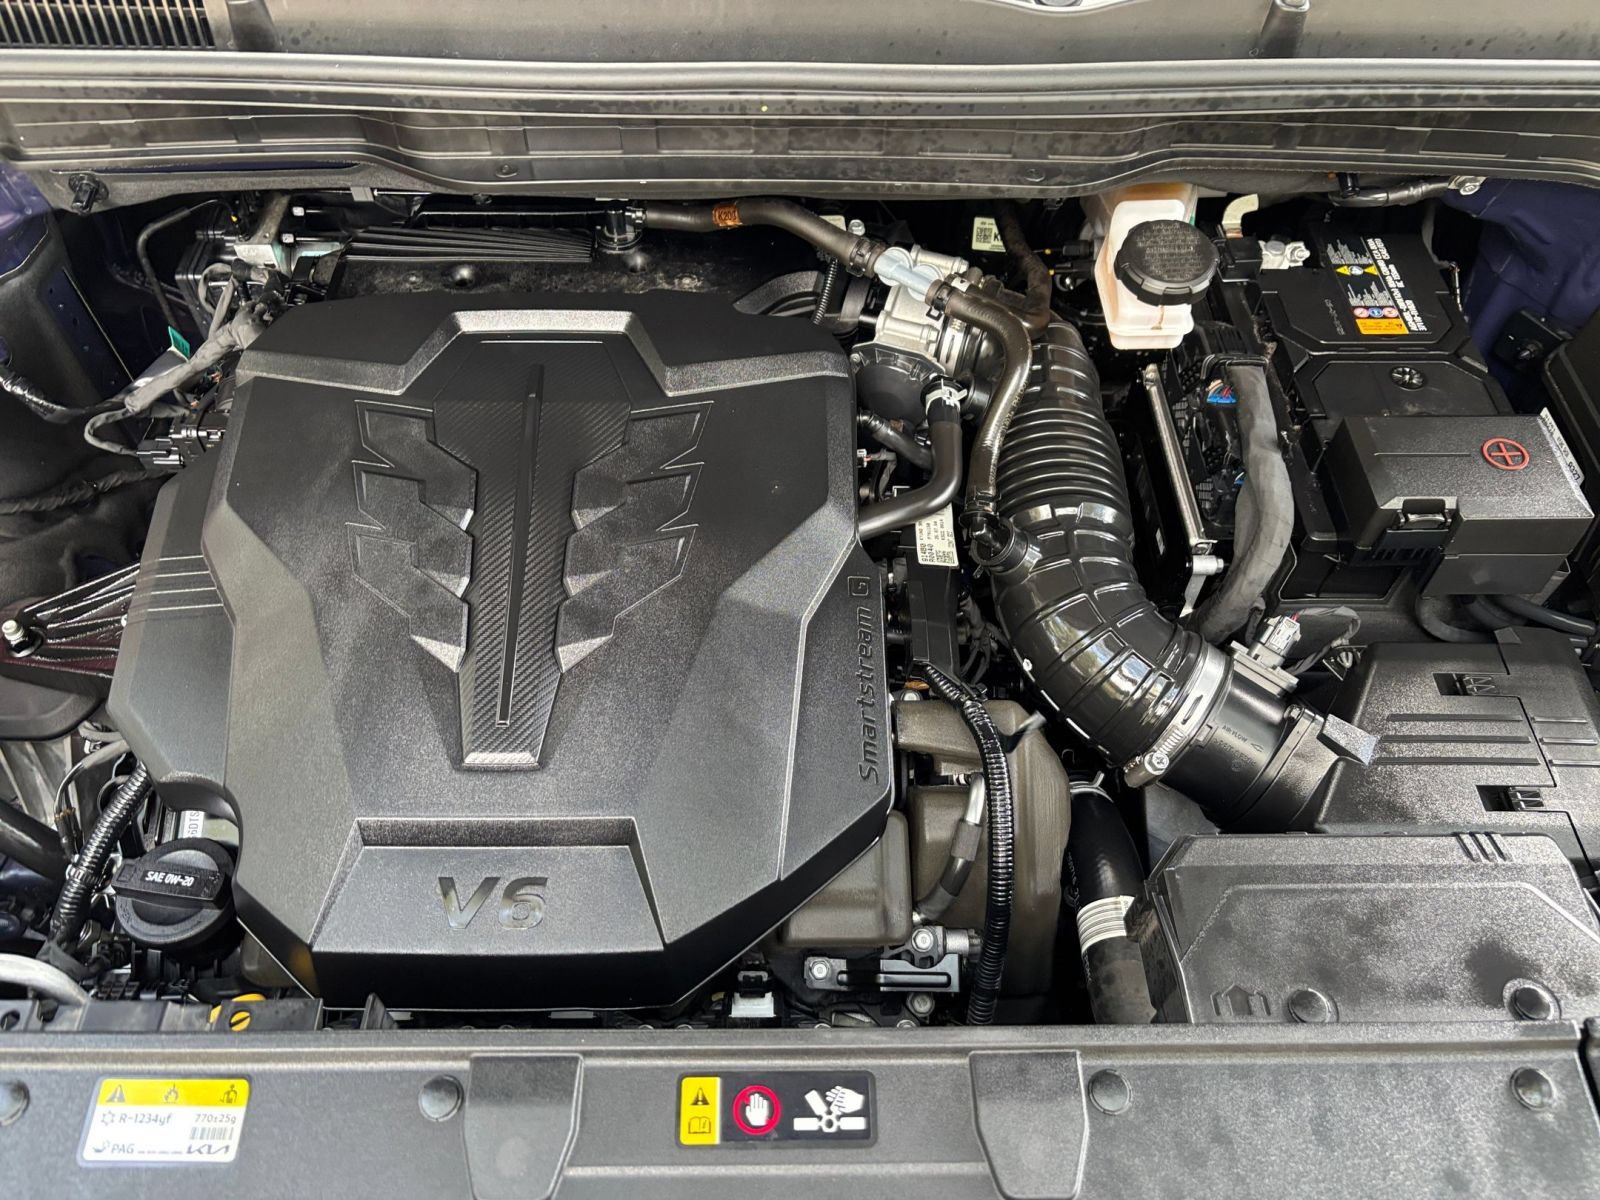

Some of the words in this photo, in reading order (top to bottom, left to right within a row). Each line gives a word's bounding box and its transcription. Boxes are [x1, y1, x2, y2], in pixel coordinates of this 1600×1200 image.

[855, 607, 879, 785] Smartstream
[145, 870, 164, 884] SAE
[165, 872, 194, 887] 0W-20
[437, 875, 549, 931] V6
[118, 1112, 172, 1126] R-1234yf
[194, 1113, 237, 1125] 770±25g
[110, 1143, 135, 1155] PAG
